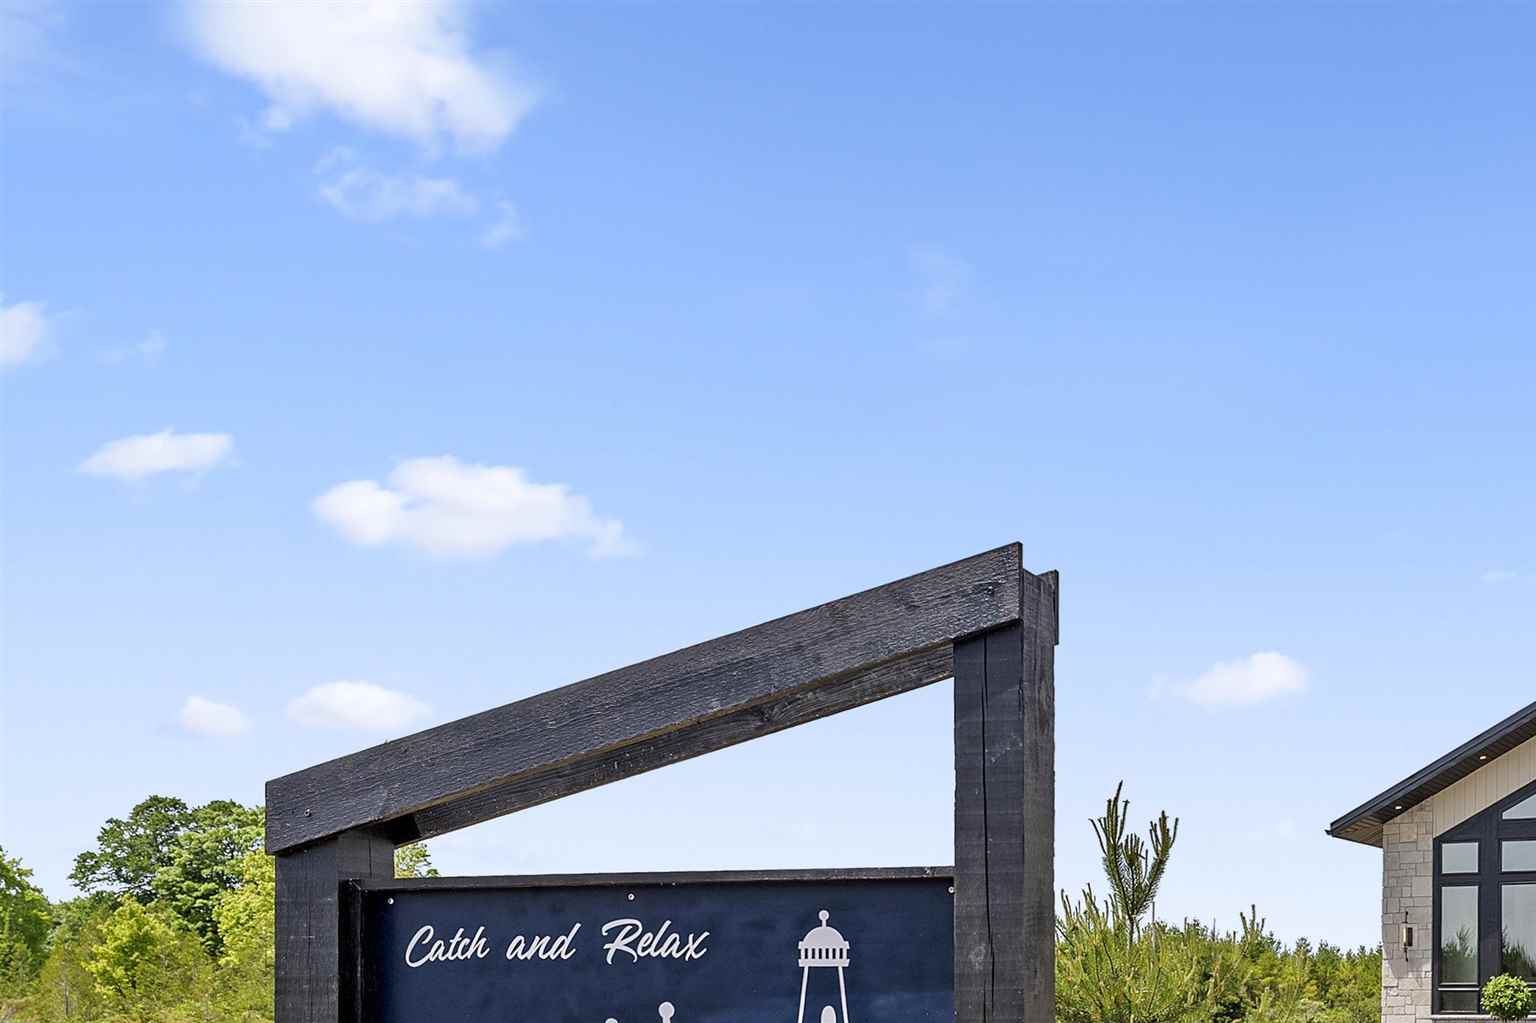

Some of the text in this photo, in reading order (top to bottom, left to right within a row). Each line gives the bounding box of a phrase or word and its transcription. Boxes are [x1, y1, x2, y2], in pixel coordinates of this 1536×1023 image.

[406, 918, 710, 968] Catch and Relax
